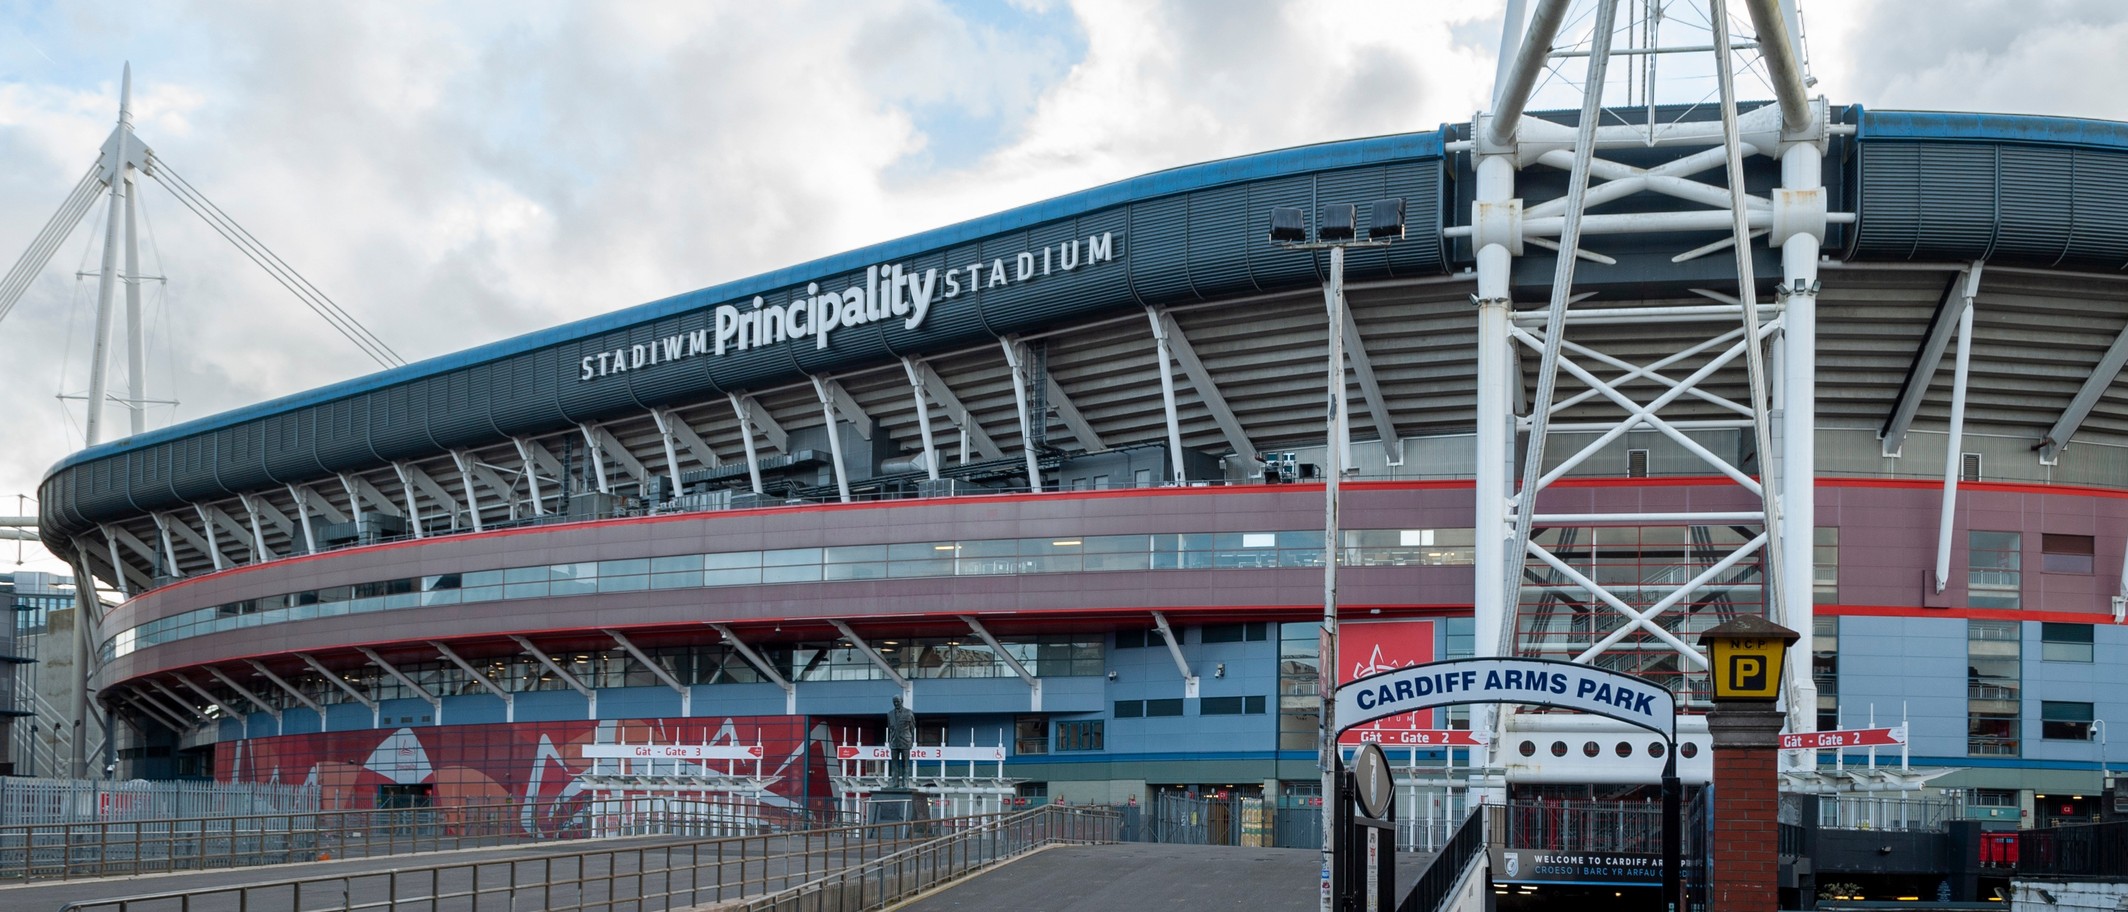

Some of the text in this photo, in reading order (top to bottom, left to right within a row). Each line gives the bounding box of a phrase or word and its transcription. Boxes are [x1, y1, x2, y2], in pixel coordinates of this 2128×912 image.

[582, 232, 1112, 380] STADIWM Principality STADIUM
[1730, 640, 1767, 649] NCP
[1736, 658, 1760, 687] P
[1356, 670, 1656, 716] CARDIFF ARMS PARK
[1360, 731, 1382, 743] Gât
[1401, 731, 1429, 743] Gate
[1441, 732, 1449, 743] 2
[1784, 735, 1802, 747] Gât
[1818, 734, 1843, 746] Gate
[1853, 732, 1860, 744] 2
[635, 747, 651, 756] Gât
[665, 747, 687, 756] Gate
[696, 748, 701, 756] 3
[873, 748, 942, 758] Gât ate 3
[1534, 855, 1584, 865] WELCOME
[1588, 856, 1601, 865] TO
[1606, 857, 1648, 867] CARDIFF
[1534, 865, 1573, 875] CROESO
[1584, 867, 1608, 876] BARC
[1612, 867, 1623, 876] YR
[1626, 868, 1655, 877] ARFAU
